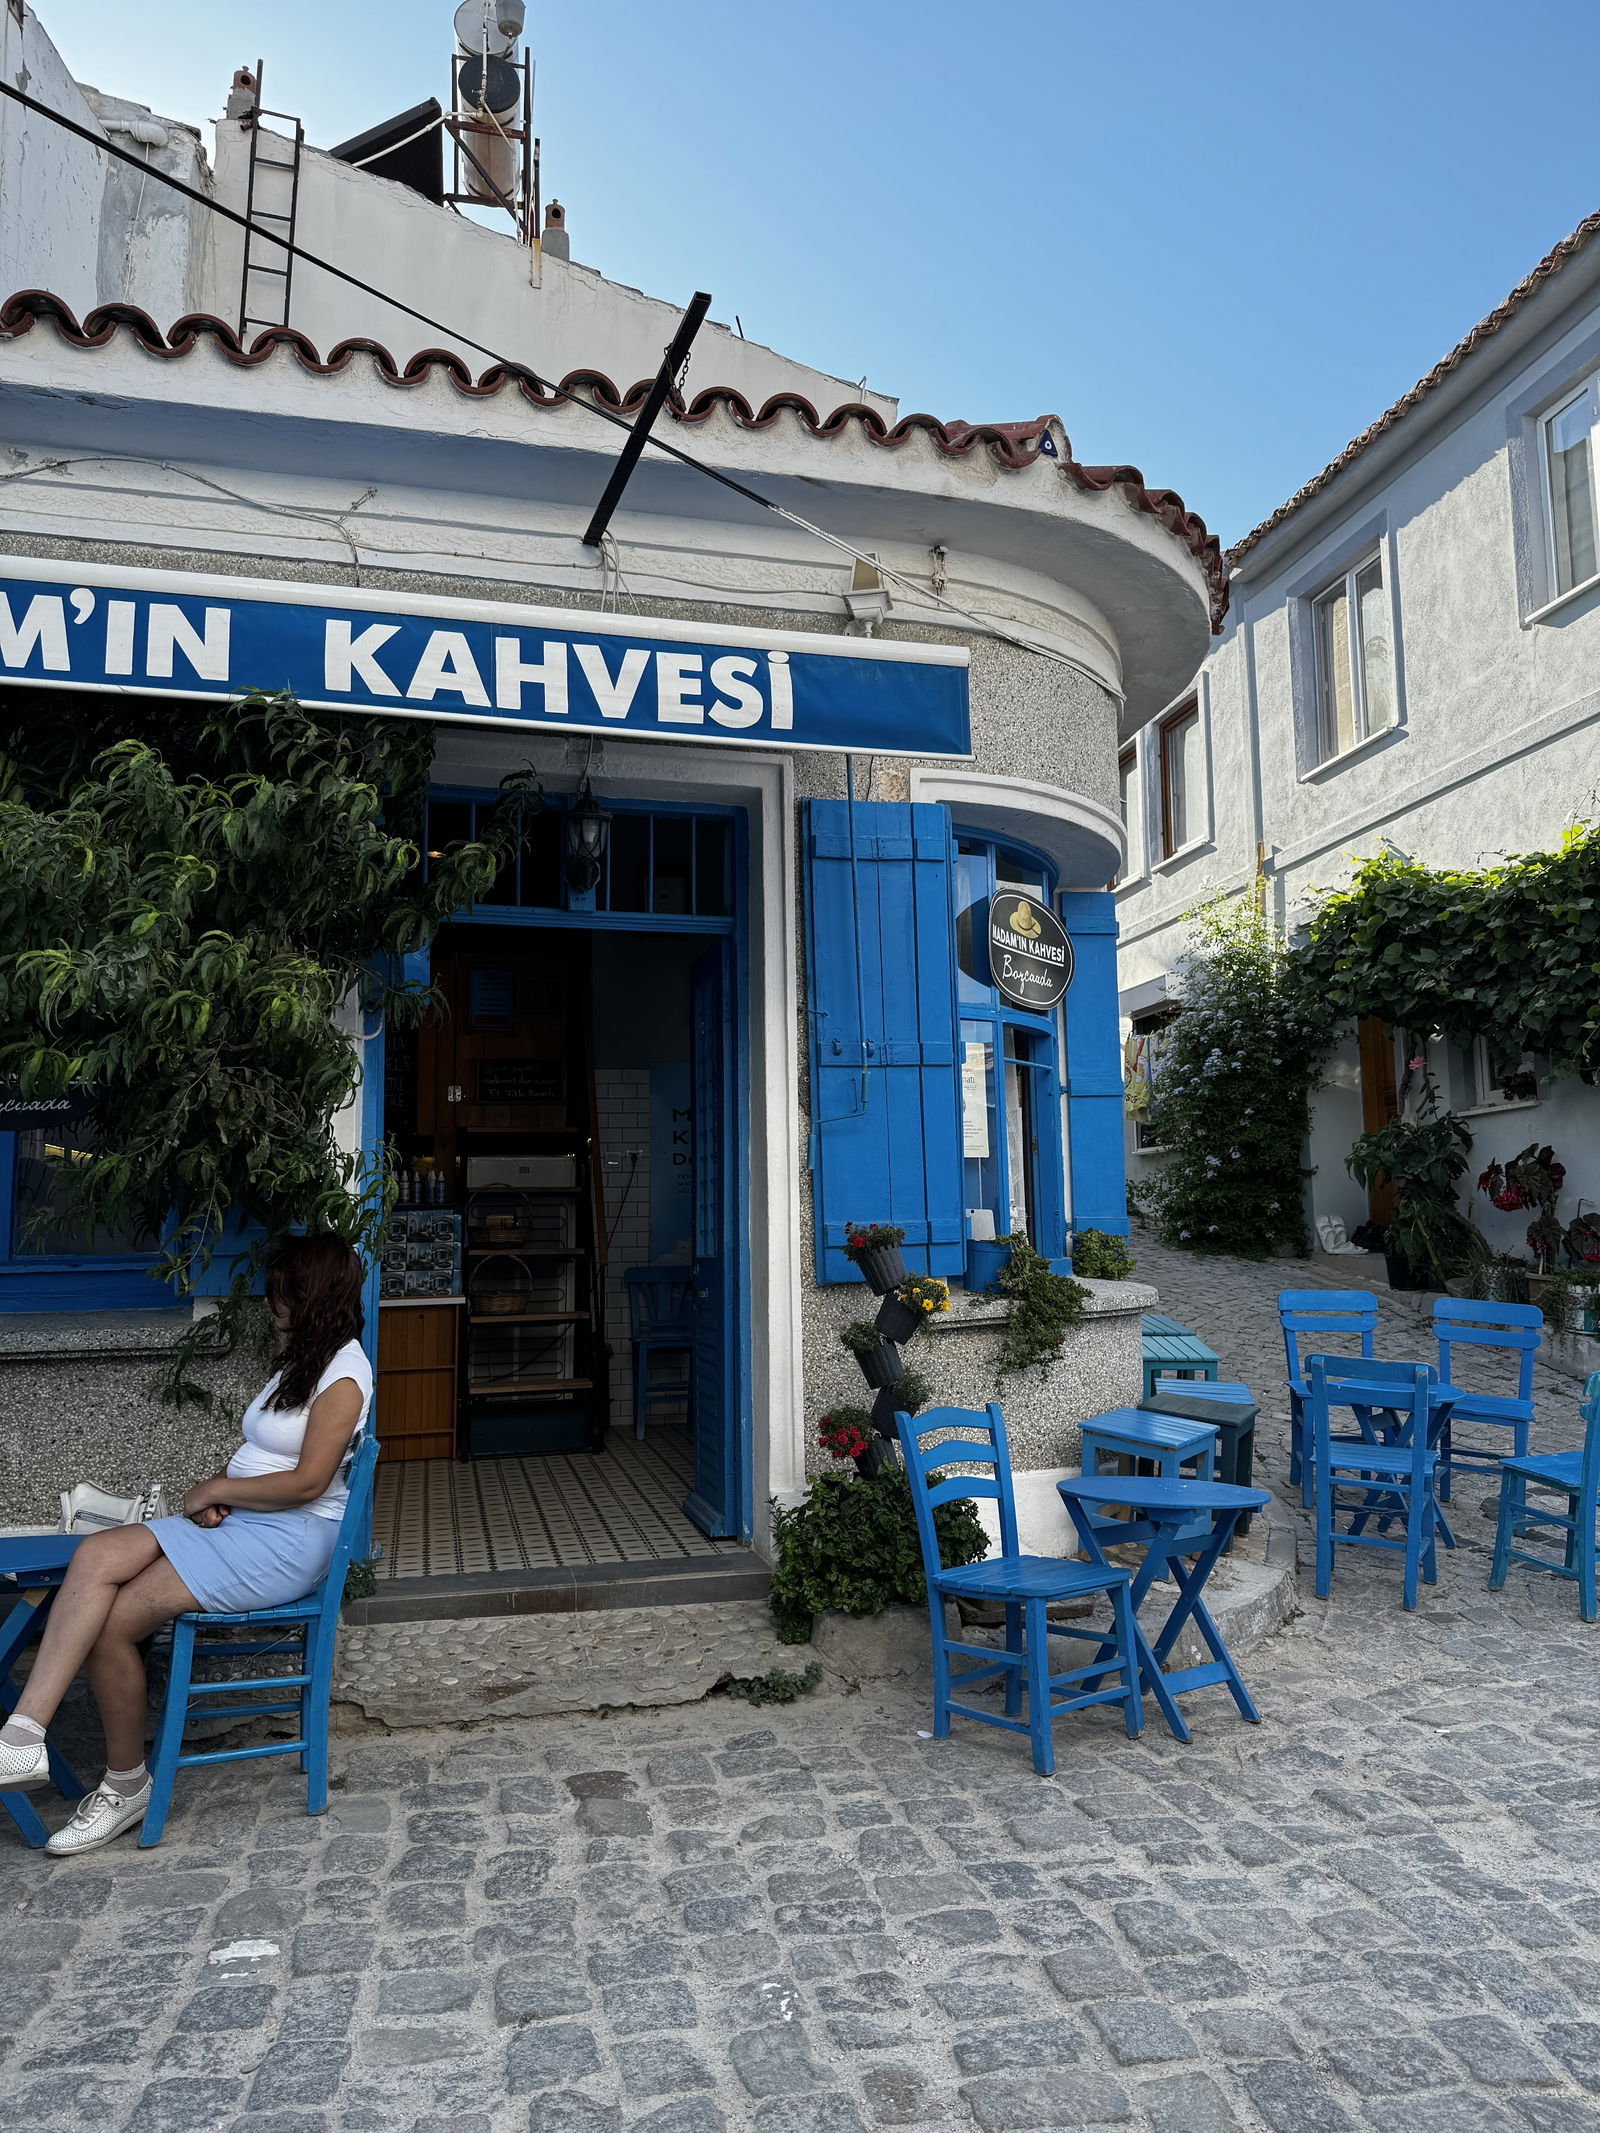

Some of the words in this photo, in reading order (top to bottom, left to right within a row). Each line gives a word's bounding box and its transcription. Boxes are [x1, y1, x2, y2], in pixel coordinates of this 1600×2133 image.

[324, 619, 793, 730] KAHVESİ
[992, 923, 1027, 952] MADAM'IN
[1028, 939, 1065, 963] KAHVESİ
